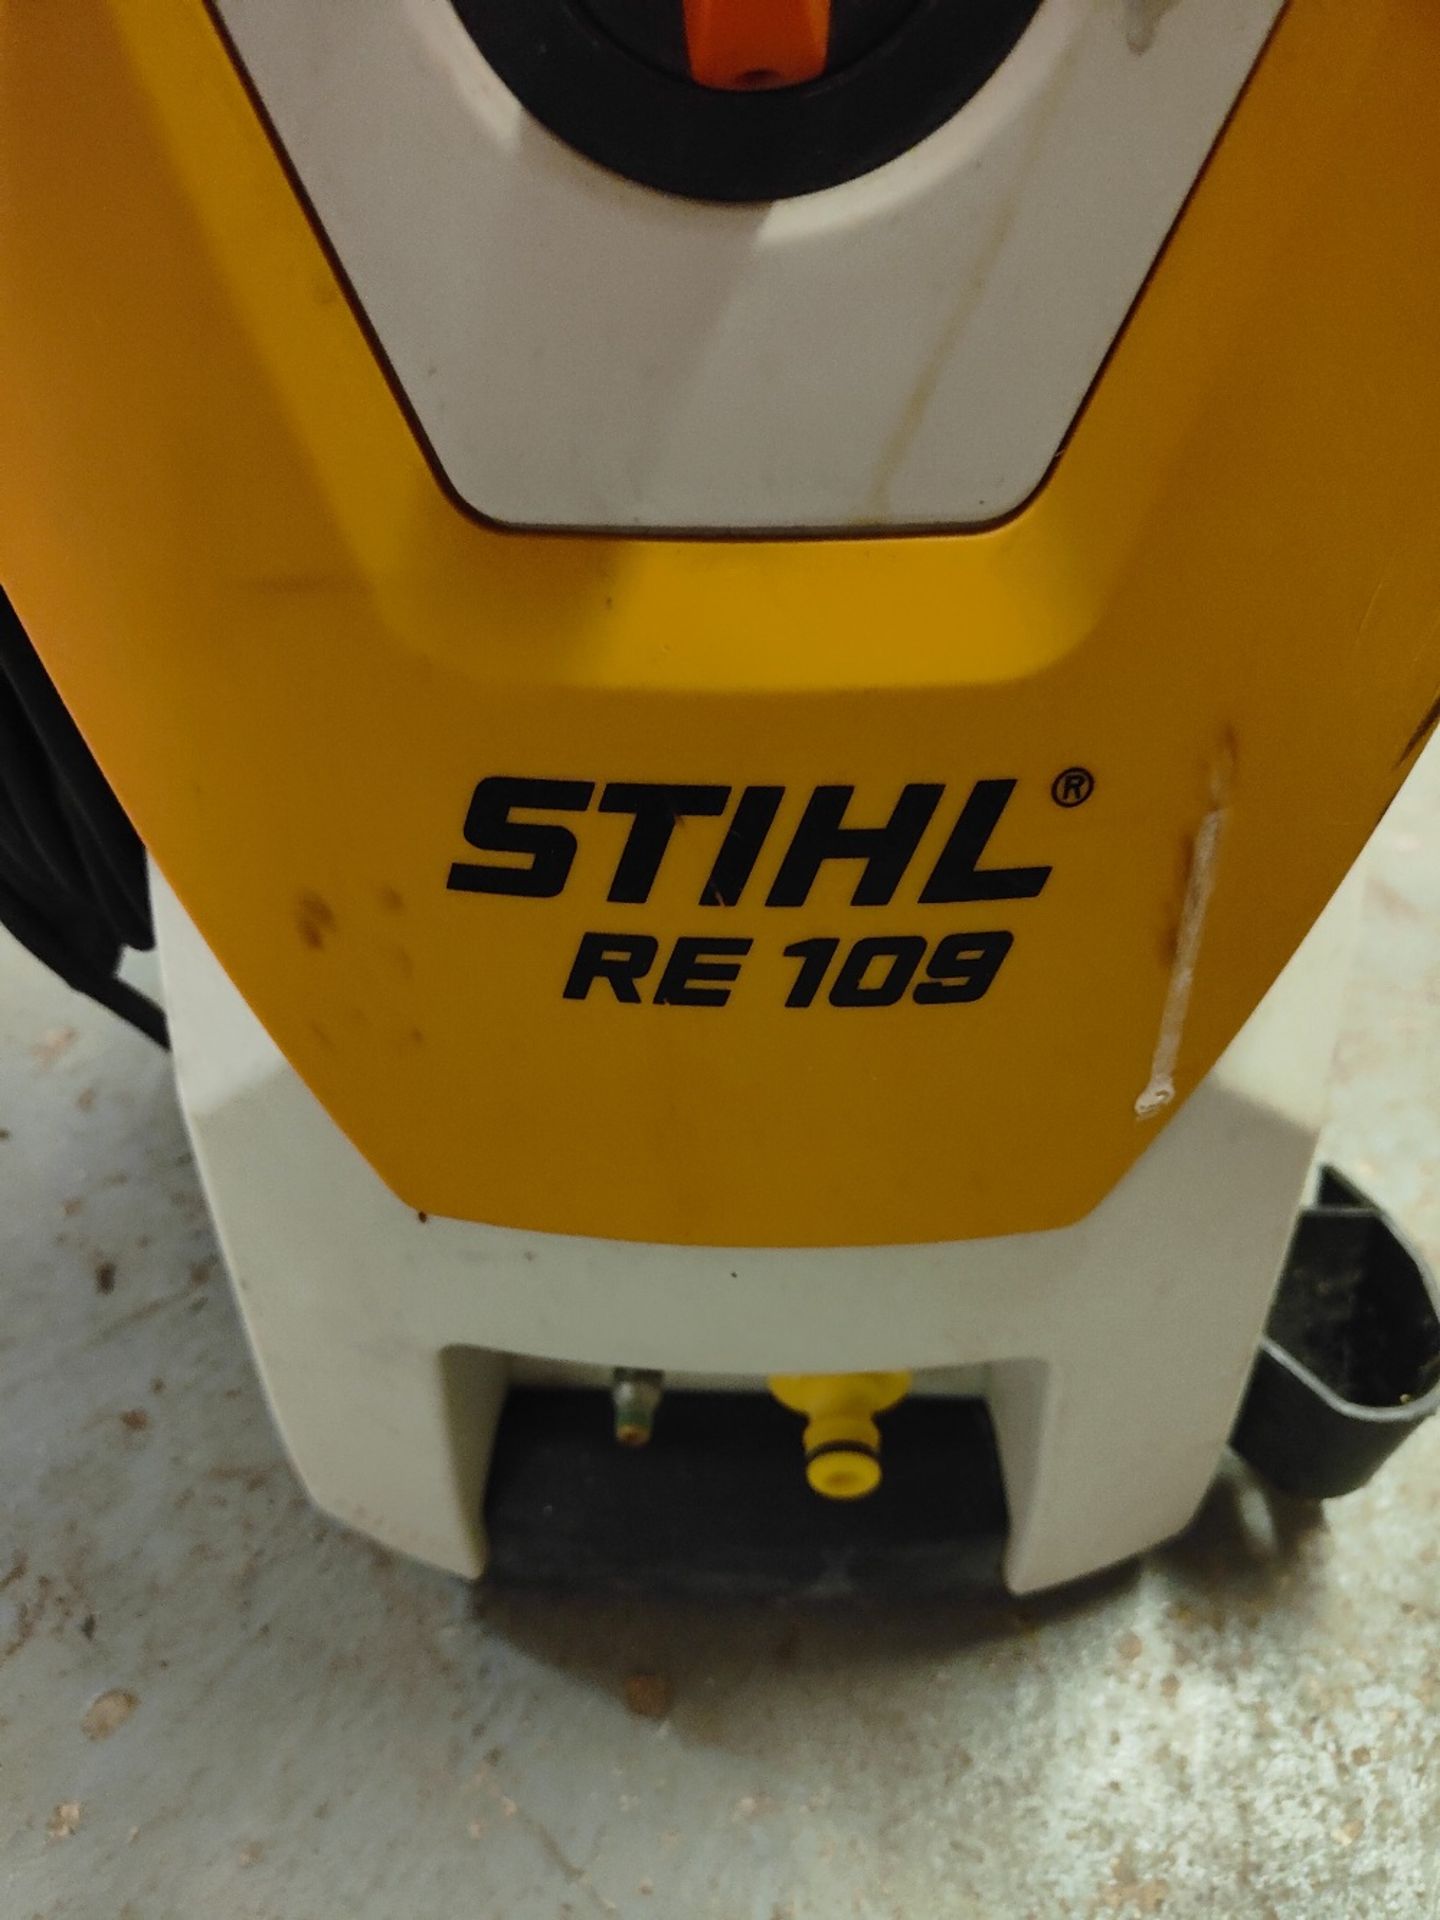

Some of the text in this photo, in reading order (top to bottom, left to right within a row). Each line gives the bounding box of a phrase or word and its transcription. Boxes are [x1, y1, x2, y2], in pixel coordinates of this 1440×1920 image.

[446, 775, 1053, 908] STIHL
[562, 929, 1015, 1009] RE 109
